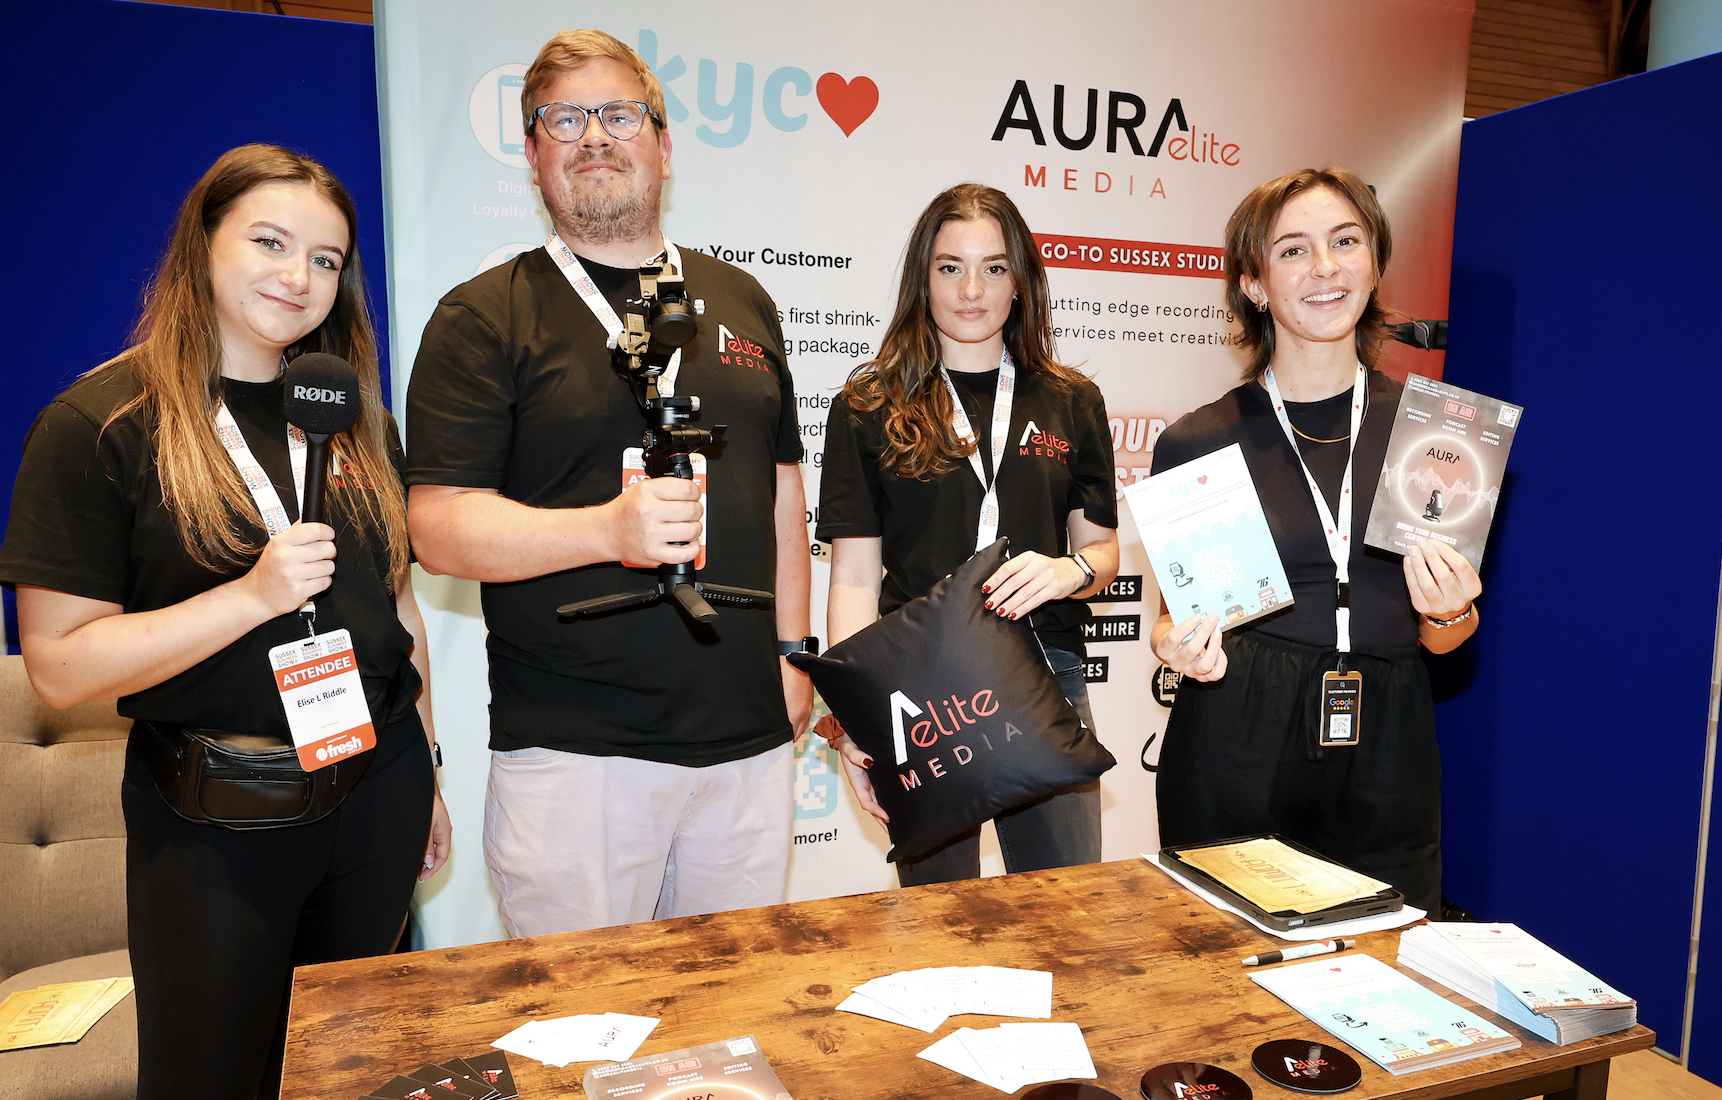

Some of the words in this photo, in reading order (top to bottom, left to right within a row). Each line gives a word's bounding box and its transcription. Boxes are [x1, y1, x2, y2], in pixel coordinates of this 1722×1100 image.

[638, 28, 812, 148] kyc
[991, 79, 1189, 157] AURA
[1168, 125, 1240, 166] elite
[498, 180, 541, 196] Digita
[1024, 164, 1167, 199] MEDIA
[472, 203, 527, 219] Loyalty
[709, 245, 755, 263] Your
[761, 248, 852, 269] Customer
[1040, 242, 1103, 263] GO-TO
[1110, 247, 1171, 267] SUSSEX
[1177, 253, 1225, 272] STUDI
[789, 308, 820, 325] first
[825, 310, 881, 327] shrink-
[1048, 298, 1101, 316] utting
[1107, 301, 1150, 317] edge
[1156, 303, 1236, 323] recording
[1122, 328, 1165, 344] meet
[798, 338, 875, 358] package.
[720, 355, 770, 373] MEDIA
[293, 385, 347, 405] RØDE
[1406, 407, 1432, 418] RECORDING
[1407, 414, 1427, 424] SERVICES
[1458, 404, 1474, 418] AIR
[1442, 424, 1456, 433] ROOM
[1456, 428, 1467, 436] HIRE
[1445, 419, 1467, 429] PODCAST
[1480, 436, 1500, 446] SERVICES
[1482, 430, 1501, 439] EDITING
[1426, 447, 1461, 464] AURA
[240, 466, 258, 490] SHOW
[1167, 478, 1198, 499] kyc
[1396, 521, 1414, 533] BRING
[1414, 525, 1431, 537] YOUR
[1430, 529, 1458, 546] BUSINESS
[1102, 622, 1135, 637] HIRE
[300, 642, 321, 652] SUSSEX
[326, 636, 346, 645] SUSSEX
[274, 649, 296, 659] SUSSEX
[303, 653, 319, 661] SHOW
[278, 660, 294, 668] SHOW
[283, 656, 352, 687] ATTENDEE
[296, 696, 315, 708] Elise
[316, 694, 322, 702] L
[323, 687, 347, 700] Riddle
[1329, 697, 1354, 707] Google
[327, 736, 362, 758] fresh
[898, 721, 1023, 792] MEDIA
[794, 829, 837, 845] more!
[1239, 859, 1298, 882] ADMIT
[658, 1064, 676, 1075] ON
[678, 1061, 697, 1071] AIR
[723, 1062, 749, 1071] EDITING
[724, 1066, 753, 1075] SERVICES
[666, 1079, 688, 1087] ROOM
[668, 1072, 698, 1081] PODCAST
[607, 1082, 645, 1094] RECORDING
[613, 1088, 644, 1097] SERVICES
